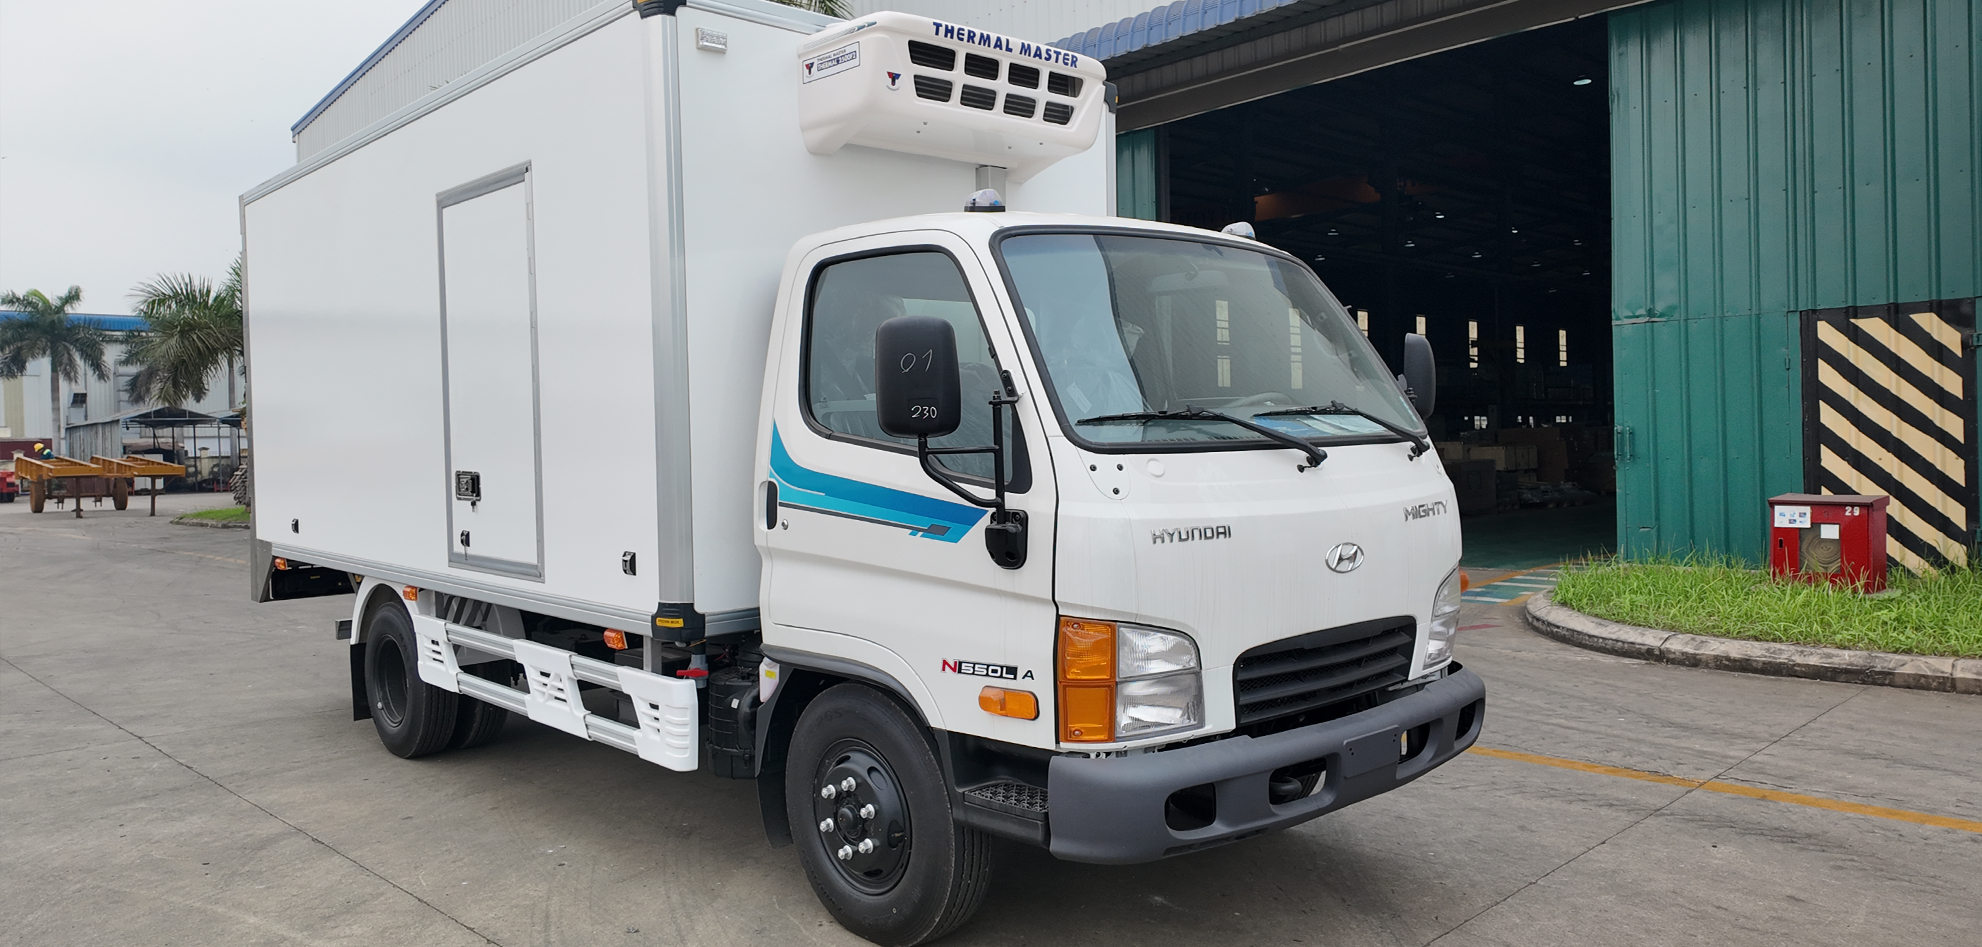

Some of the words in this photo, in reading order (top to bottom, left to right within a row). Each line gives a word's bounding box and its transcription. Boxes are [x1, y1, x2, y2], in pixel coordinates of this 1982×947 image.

[932, 21, 1014, 53] THERMAL
[1019, 41, 1079, 69] MASTER
[900, 348, 933, 374] 01
[911, 405, 938, 420] 230
[1402, 500, 1448, 522] MIGHTY
[1844, 506, 1860, 516] 29
[1150, 524, 1232, 545] HYUNDAI
[1021, 669, 1035, 680] A
